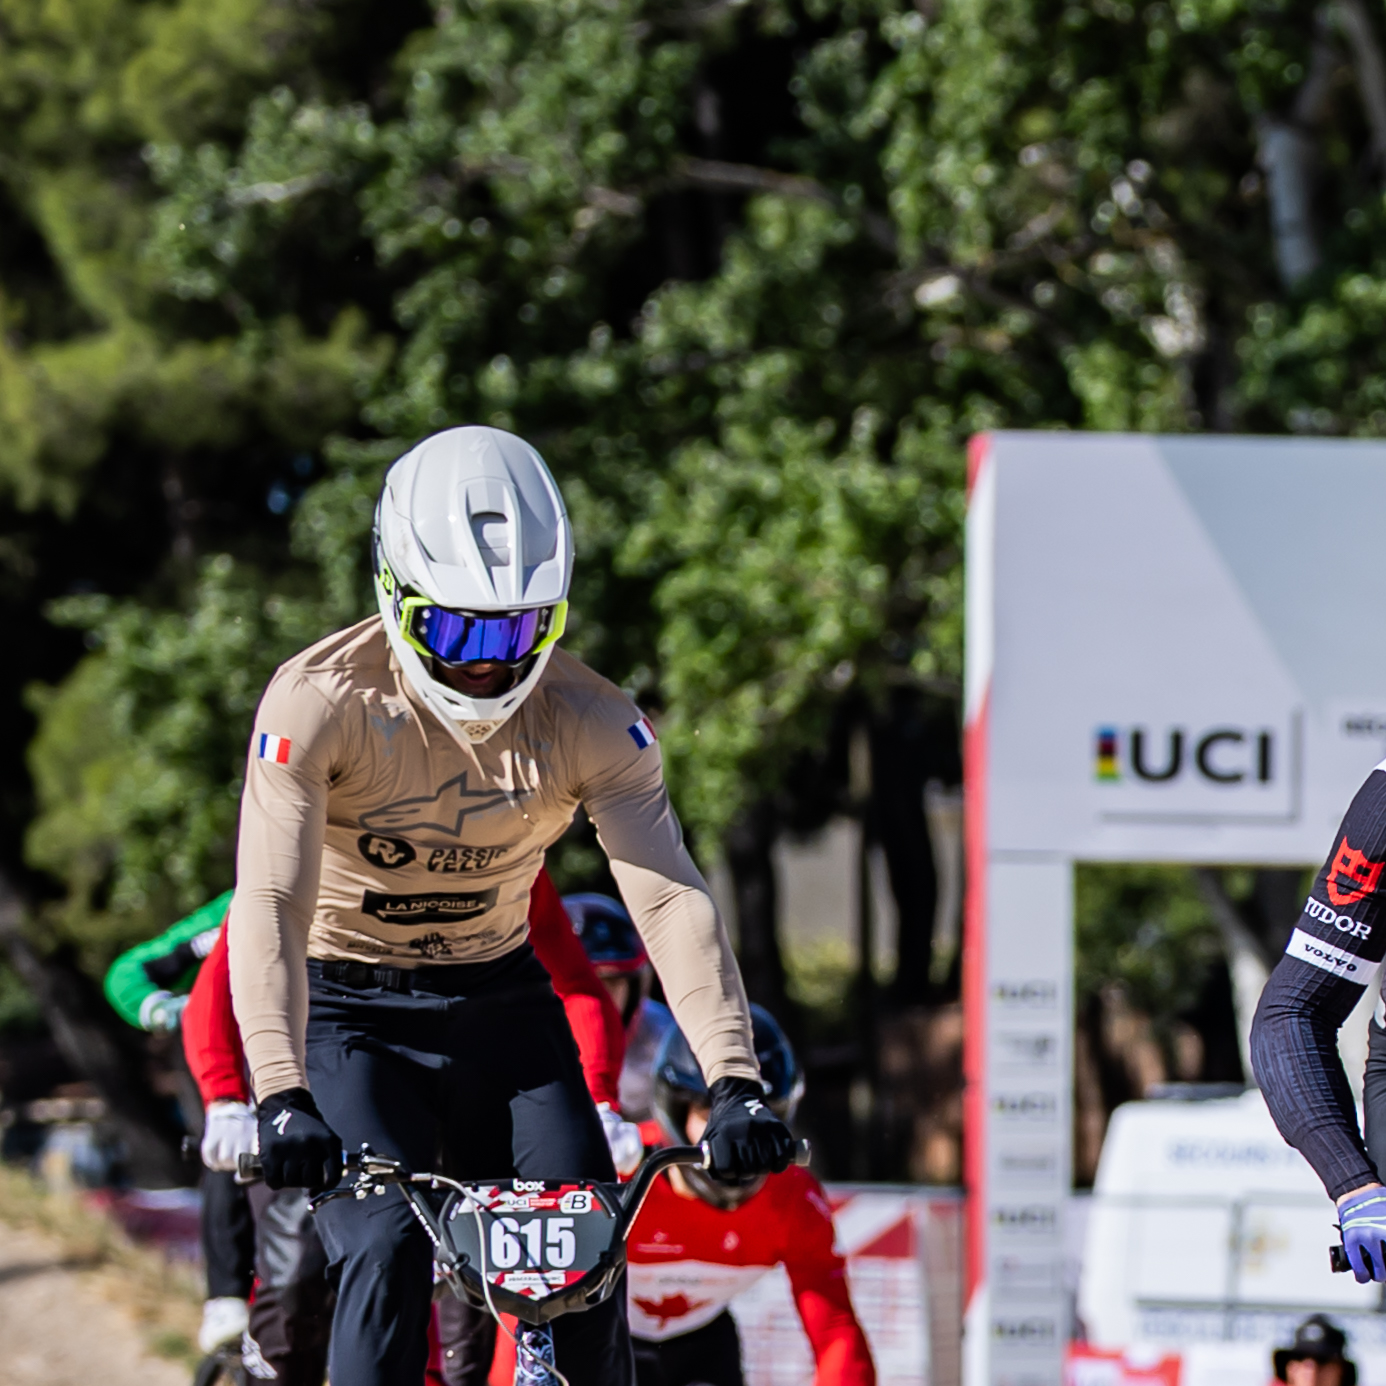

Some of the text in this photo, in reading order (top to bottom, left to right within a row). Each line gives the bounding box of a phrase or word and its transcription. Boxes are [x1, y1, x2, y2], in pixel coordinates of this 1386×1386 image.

[1131, 729, 1274, 784] UCI
[386, 902, 407, 911] LA
[1304, 896, 1372, 941] TUDOR
[1304, 943, 1358, 972] VOLVO
[513, 1178, 546, 1192] box
[507, 1198, 527, 1206] UCI
[571, 1194, 587, 1209] B
[490, 1217, 576, 1269] 615
